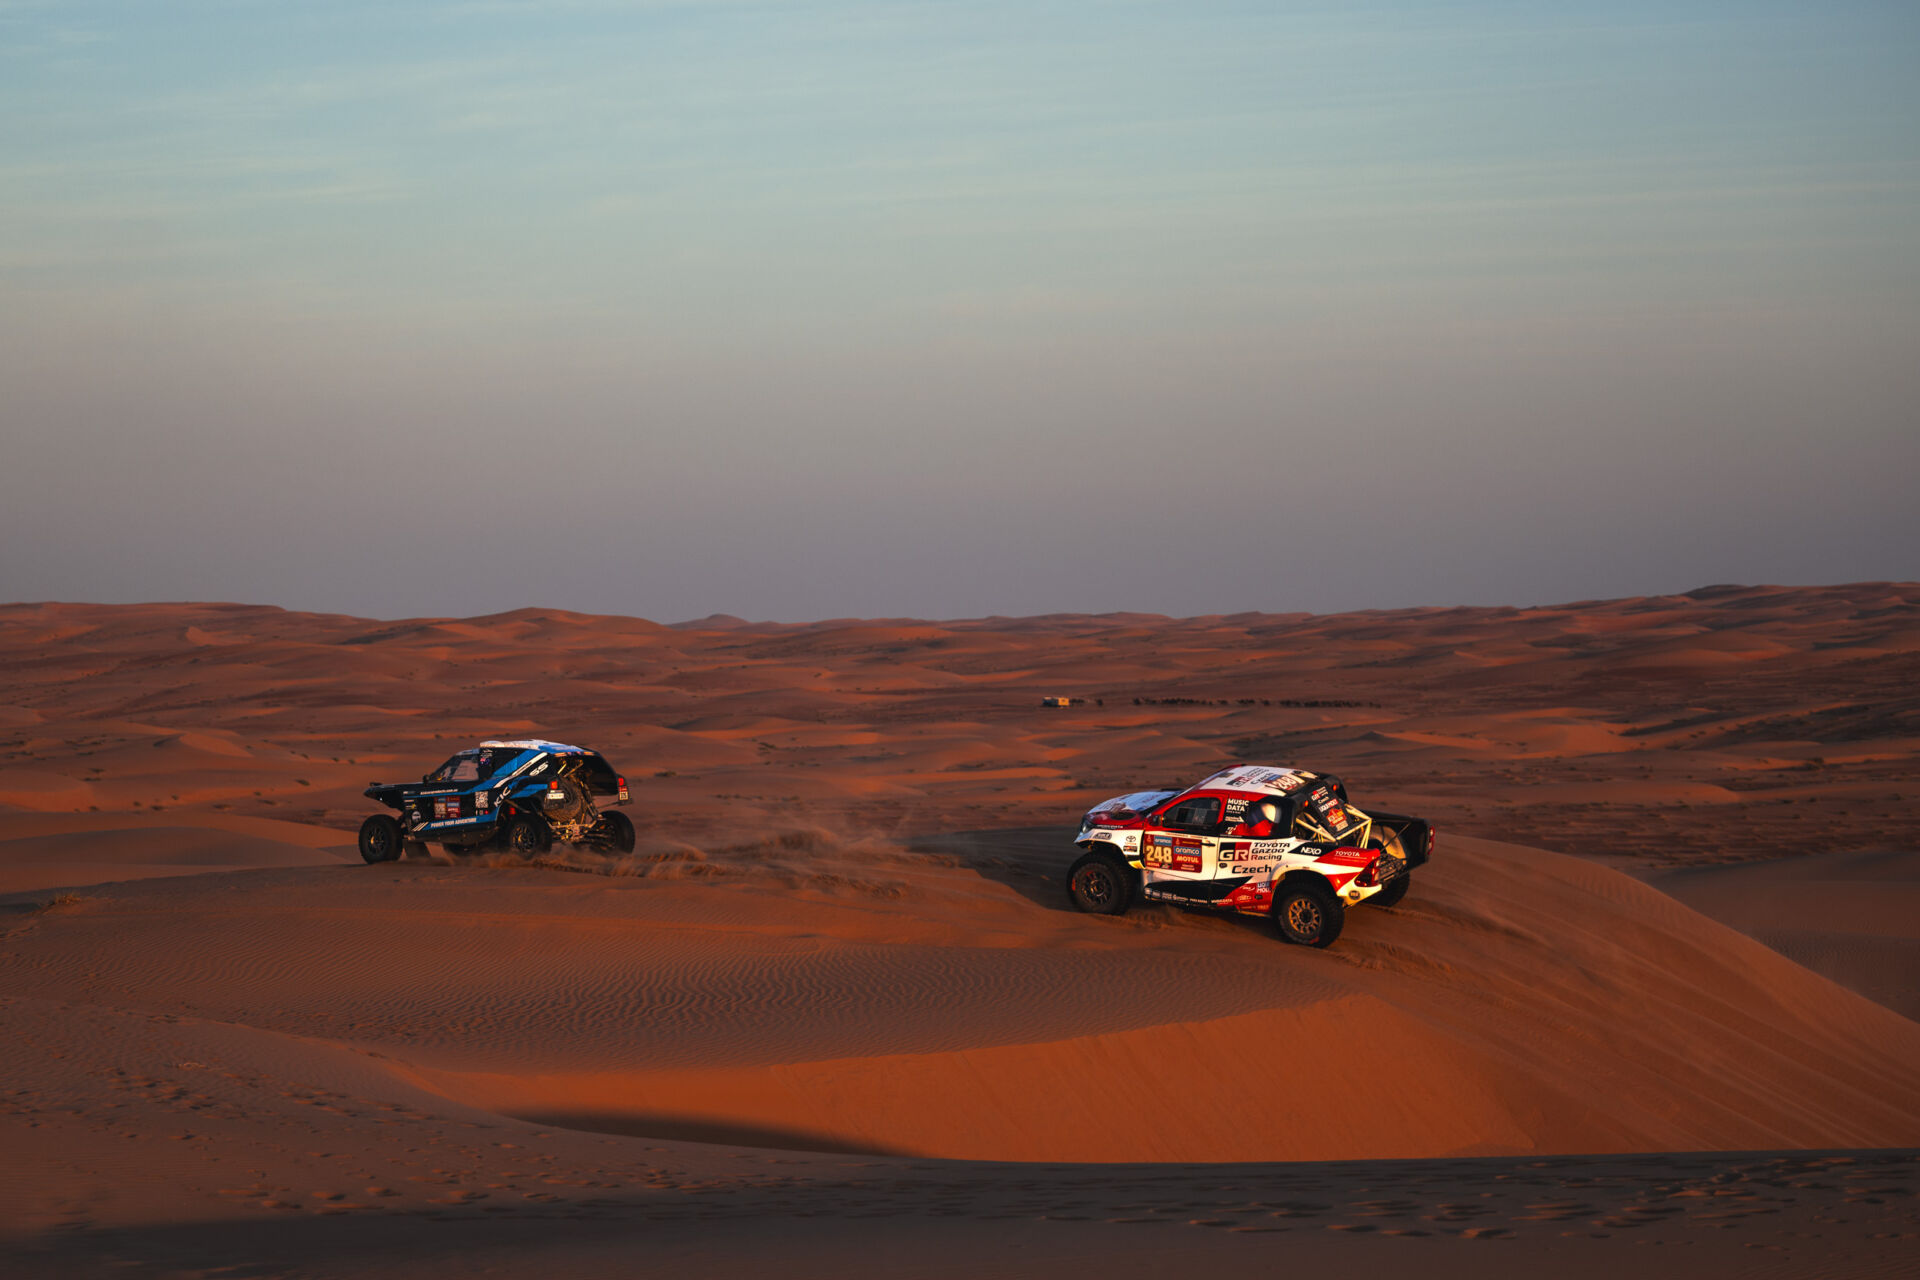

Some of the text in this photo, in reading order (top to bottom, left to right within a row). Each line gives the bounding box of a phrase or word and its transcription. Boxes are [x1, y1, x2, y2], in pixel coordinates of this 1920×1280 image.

[1228, 798, 1249, 807] MUSIC
[1226, 804, 1245, 812] DATA
[1146, 845, 1172, 864] 248
[1176, 847, 1200, 855] aramco
[1220, 849, 1249, 861] GR
[1300, 846, 1321, 855] NEXO
[1176, 855, 1199, 864] MOTUL
[1251, 854, 1282, 862] Racing
[1231, 864, 1272, 874] Czech
